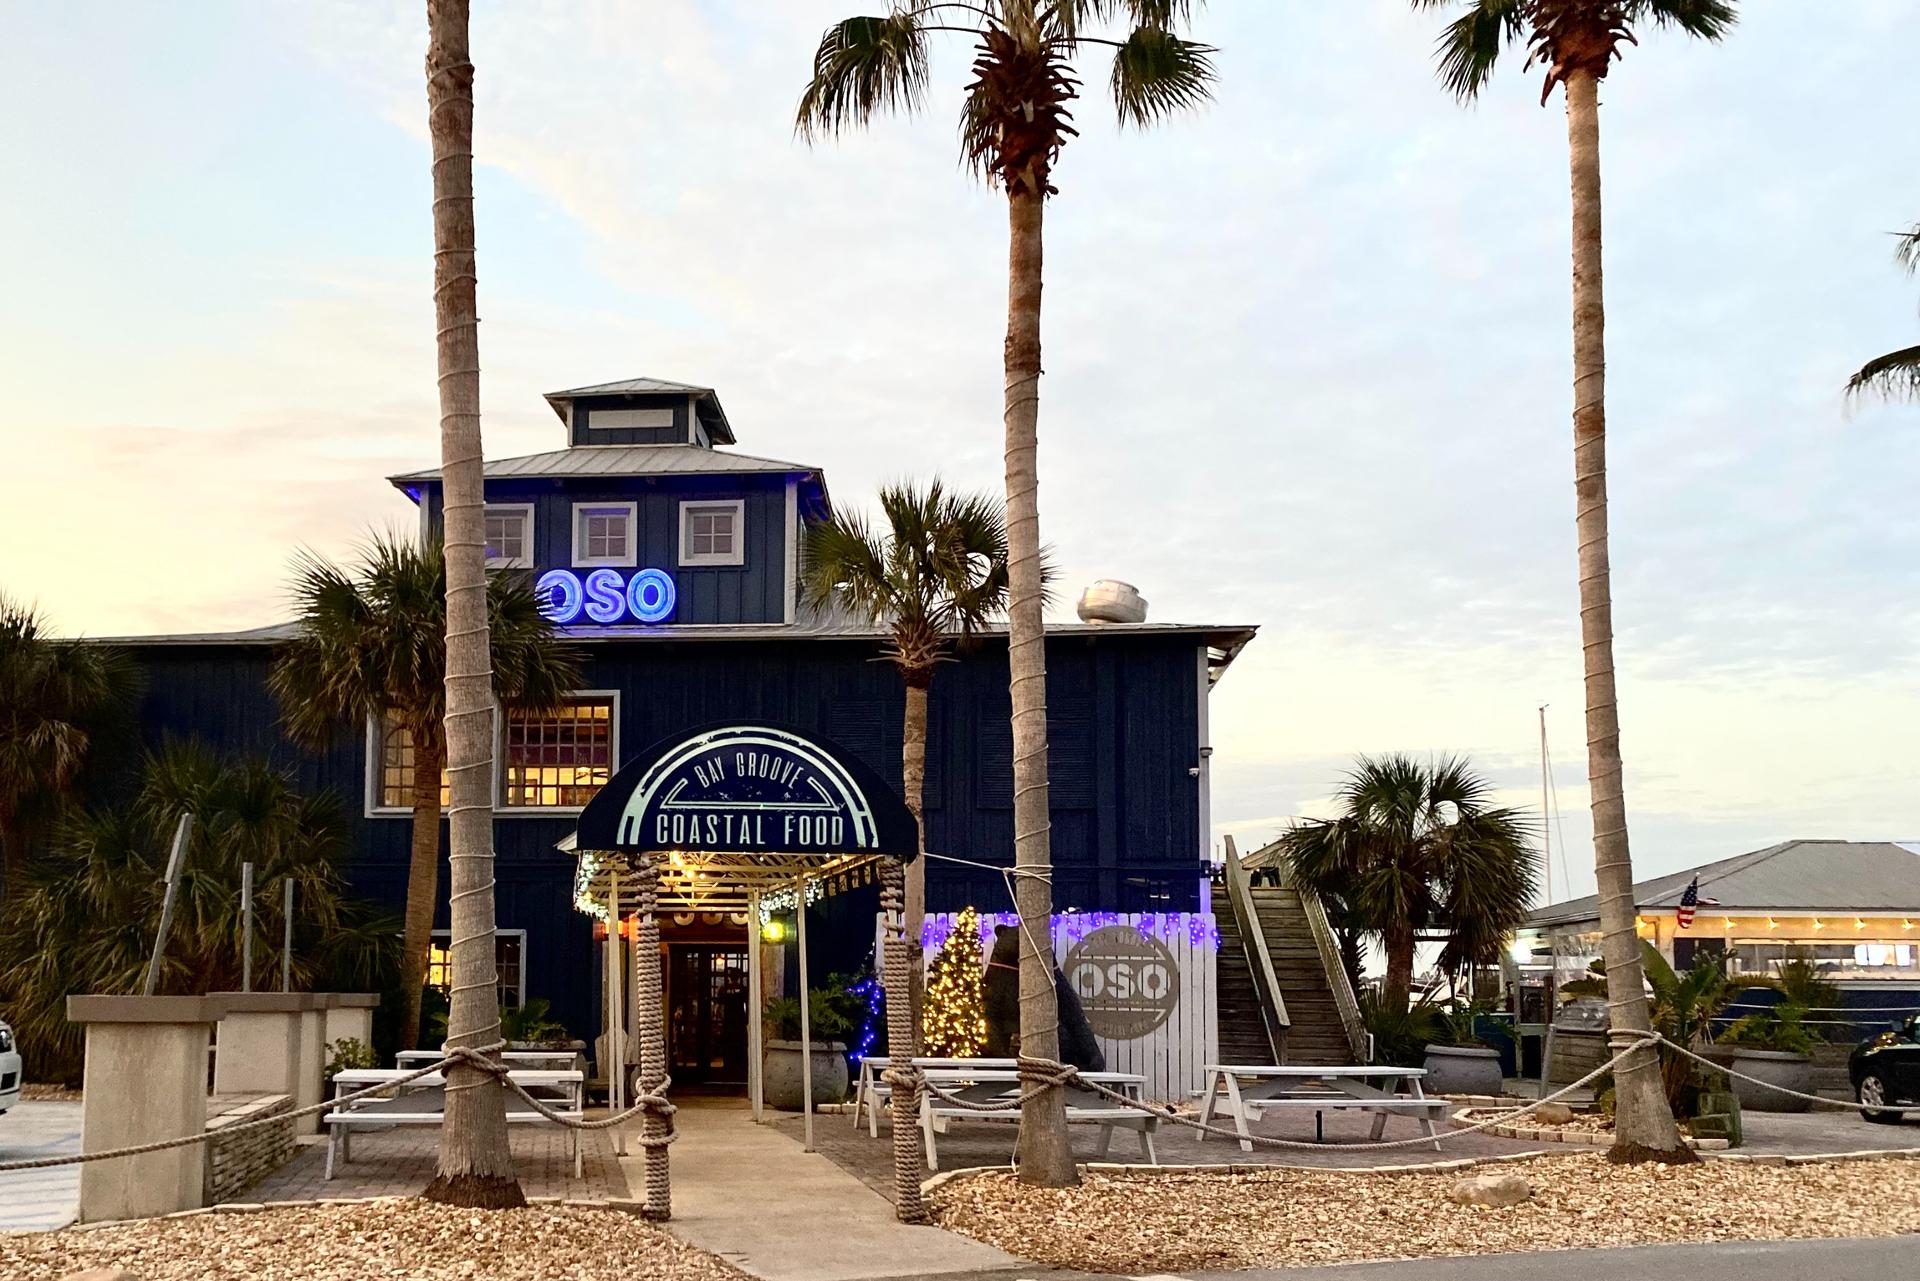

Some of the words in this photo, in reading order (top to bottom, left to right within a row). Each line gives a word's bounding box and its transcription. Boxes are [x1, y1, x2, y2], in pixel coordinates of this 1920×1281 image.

[534, 568, 676, 623] OSO
[694, 756, 725, 788] BAY
[736, 752, 804, 790] GROOVE
[656, 814, 765, 845] COASTAL
[784, 815, 844, 846] FOOD
[1071, 962, 1171, 1000] OSO
